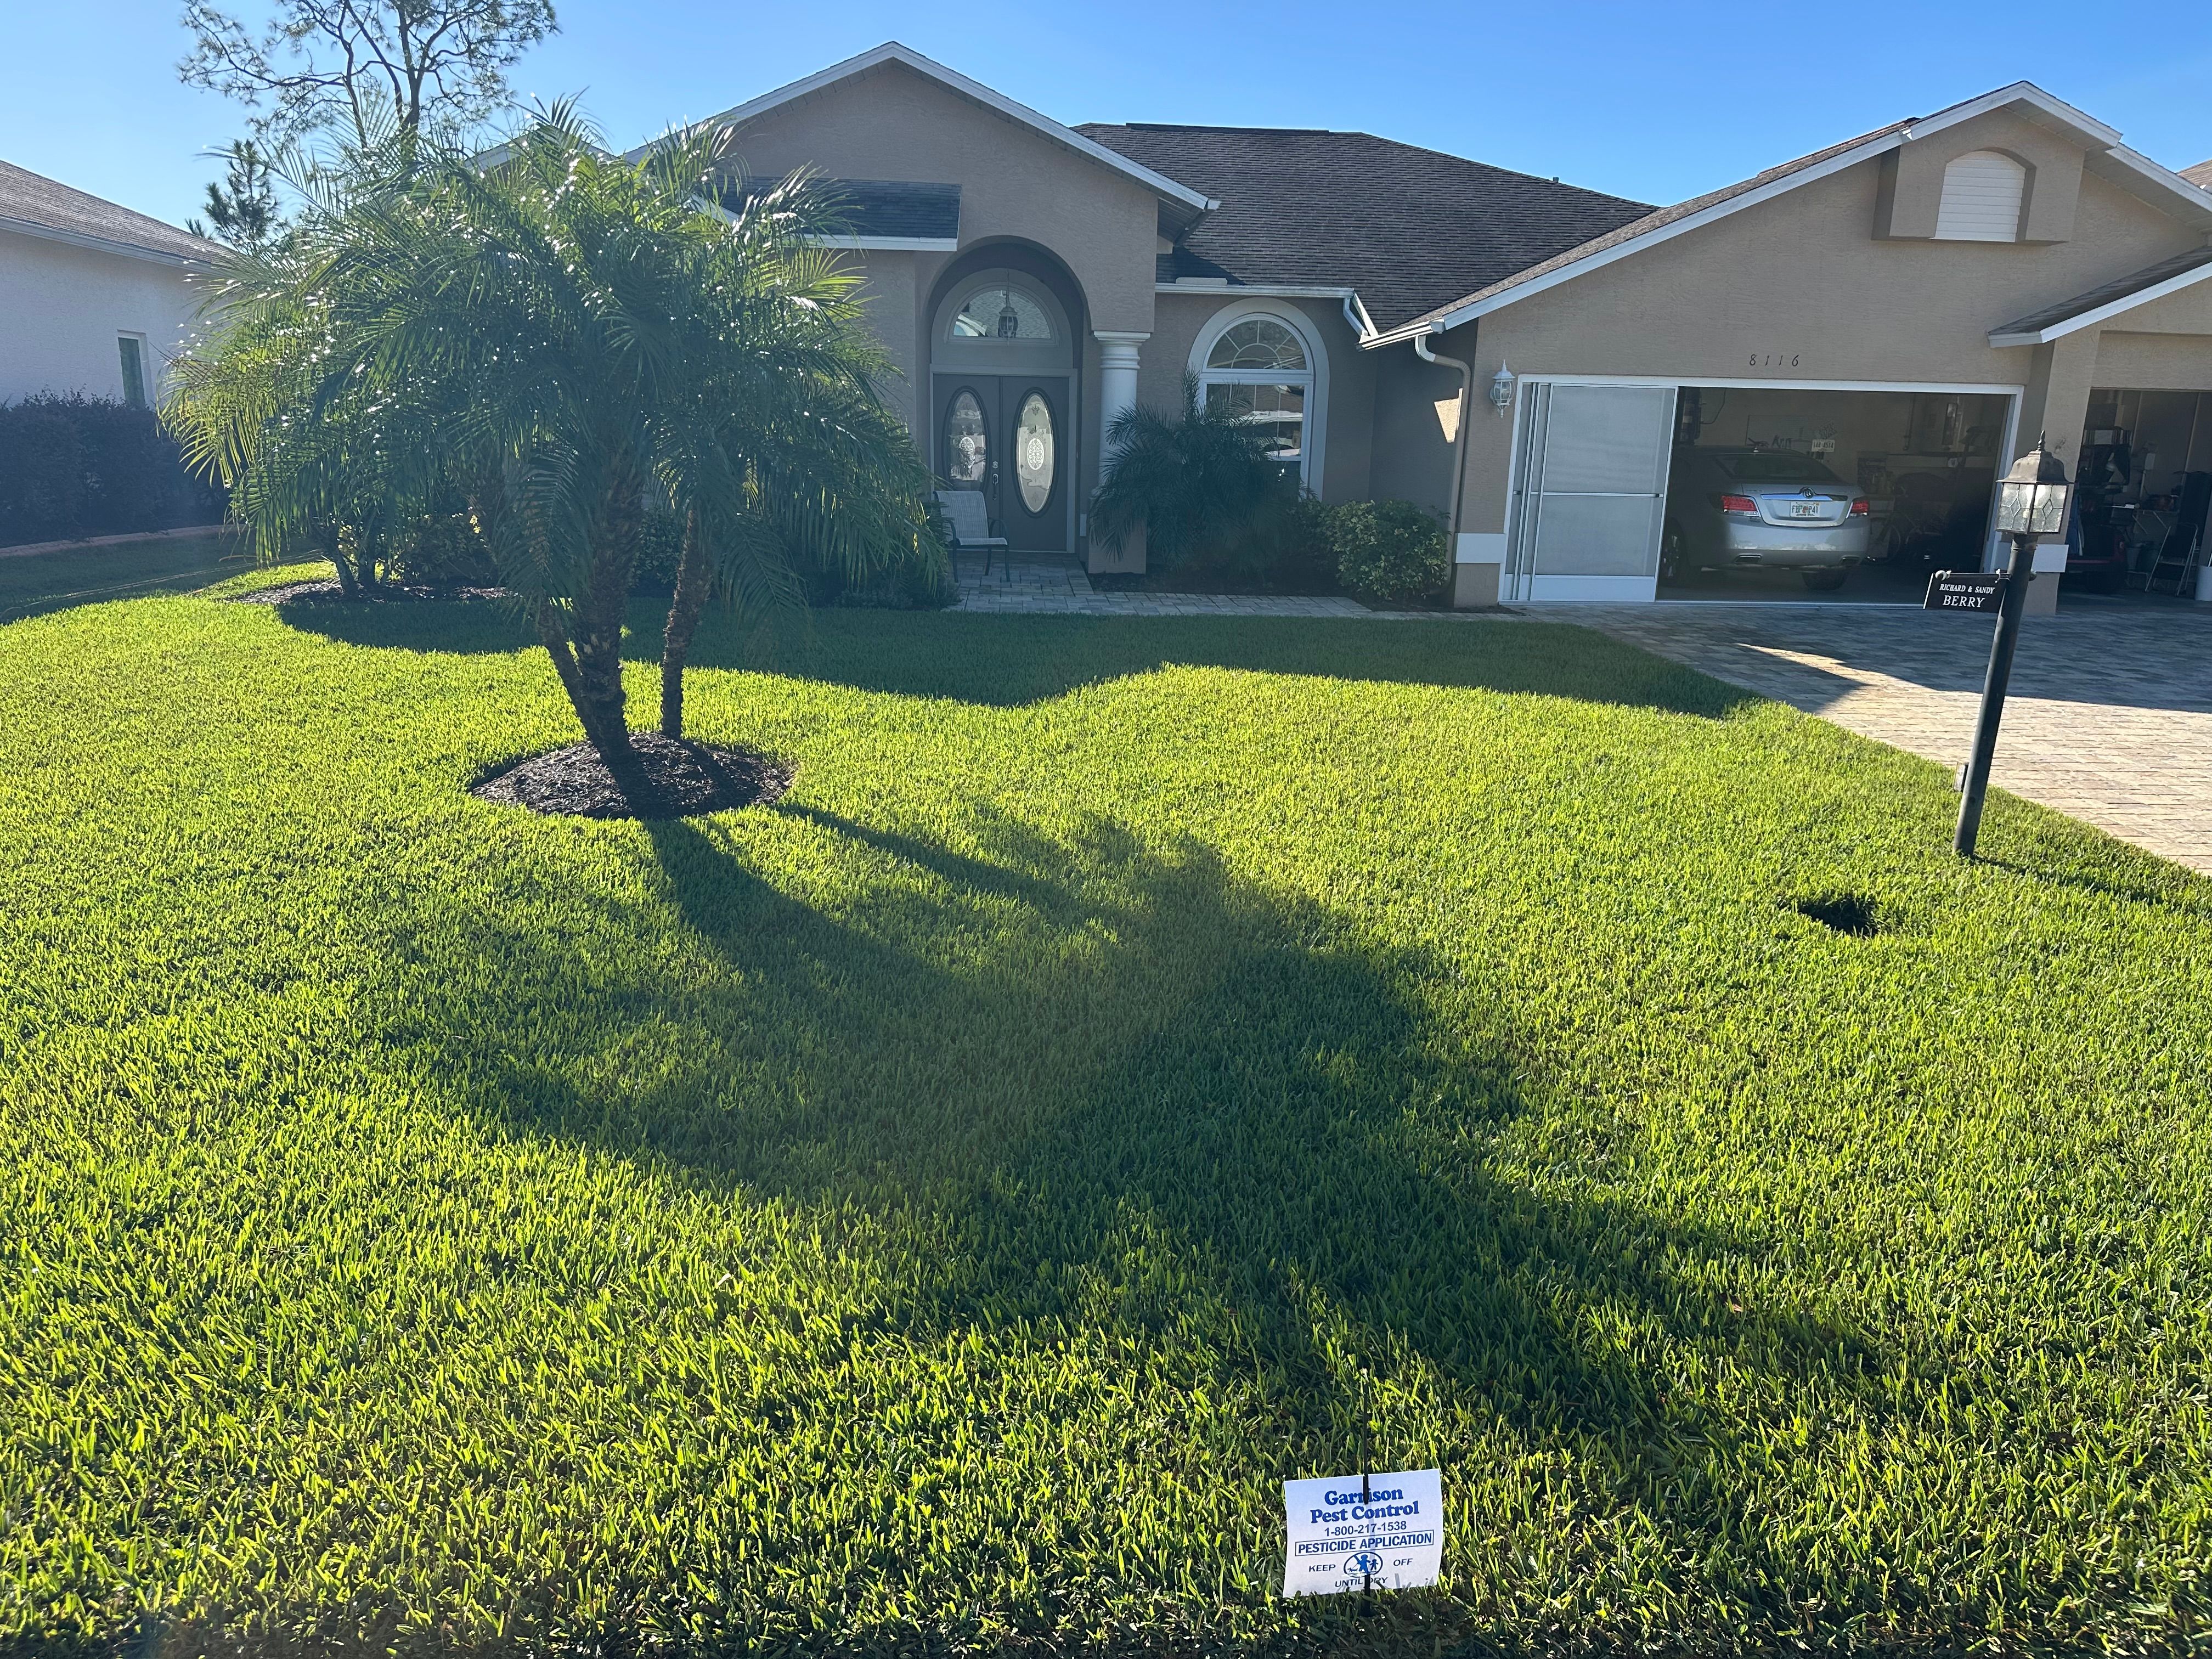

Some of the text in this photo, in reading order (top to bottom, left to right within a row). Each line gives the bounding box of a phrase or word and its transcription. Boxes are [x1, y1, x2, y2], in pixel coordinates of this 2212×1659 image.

[1749, 354, 1799, 366] 8116
[1939, 584, 1966, 592] RICHARD
[1974, 586, 1995, 594] SANDY
[1943, 595, 1985, 608] BERRY
[1310, 1500, 1419, 1523] Pest Control
[1324, 1521, 1407, 1537] 1-800-217-1538
[1298, 1533, 1432, 1554] PESTICIDE APPLICATION
[1308, 1558, 1413, 1572] KEEP OFF
[1335, 1578, 1363, 1588] UNTIL
